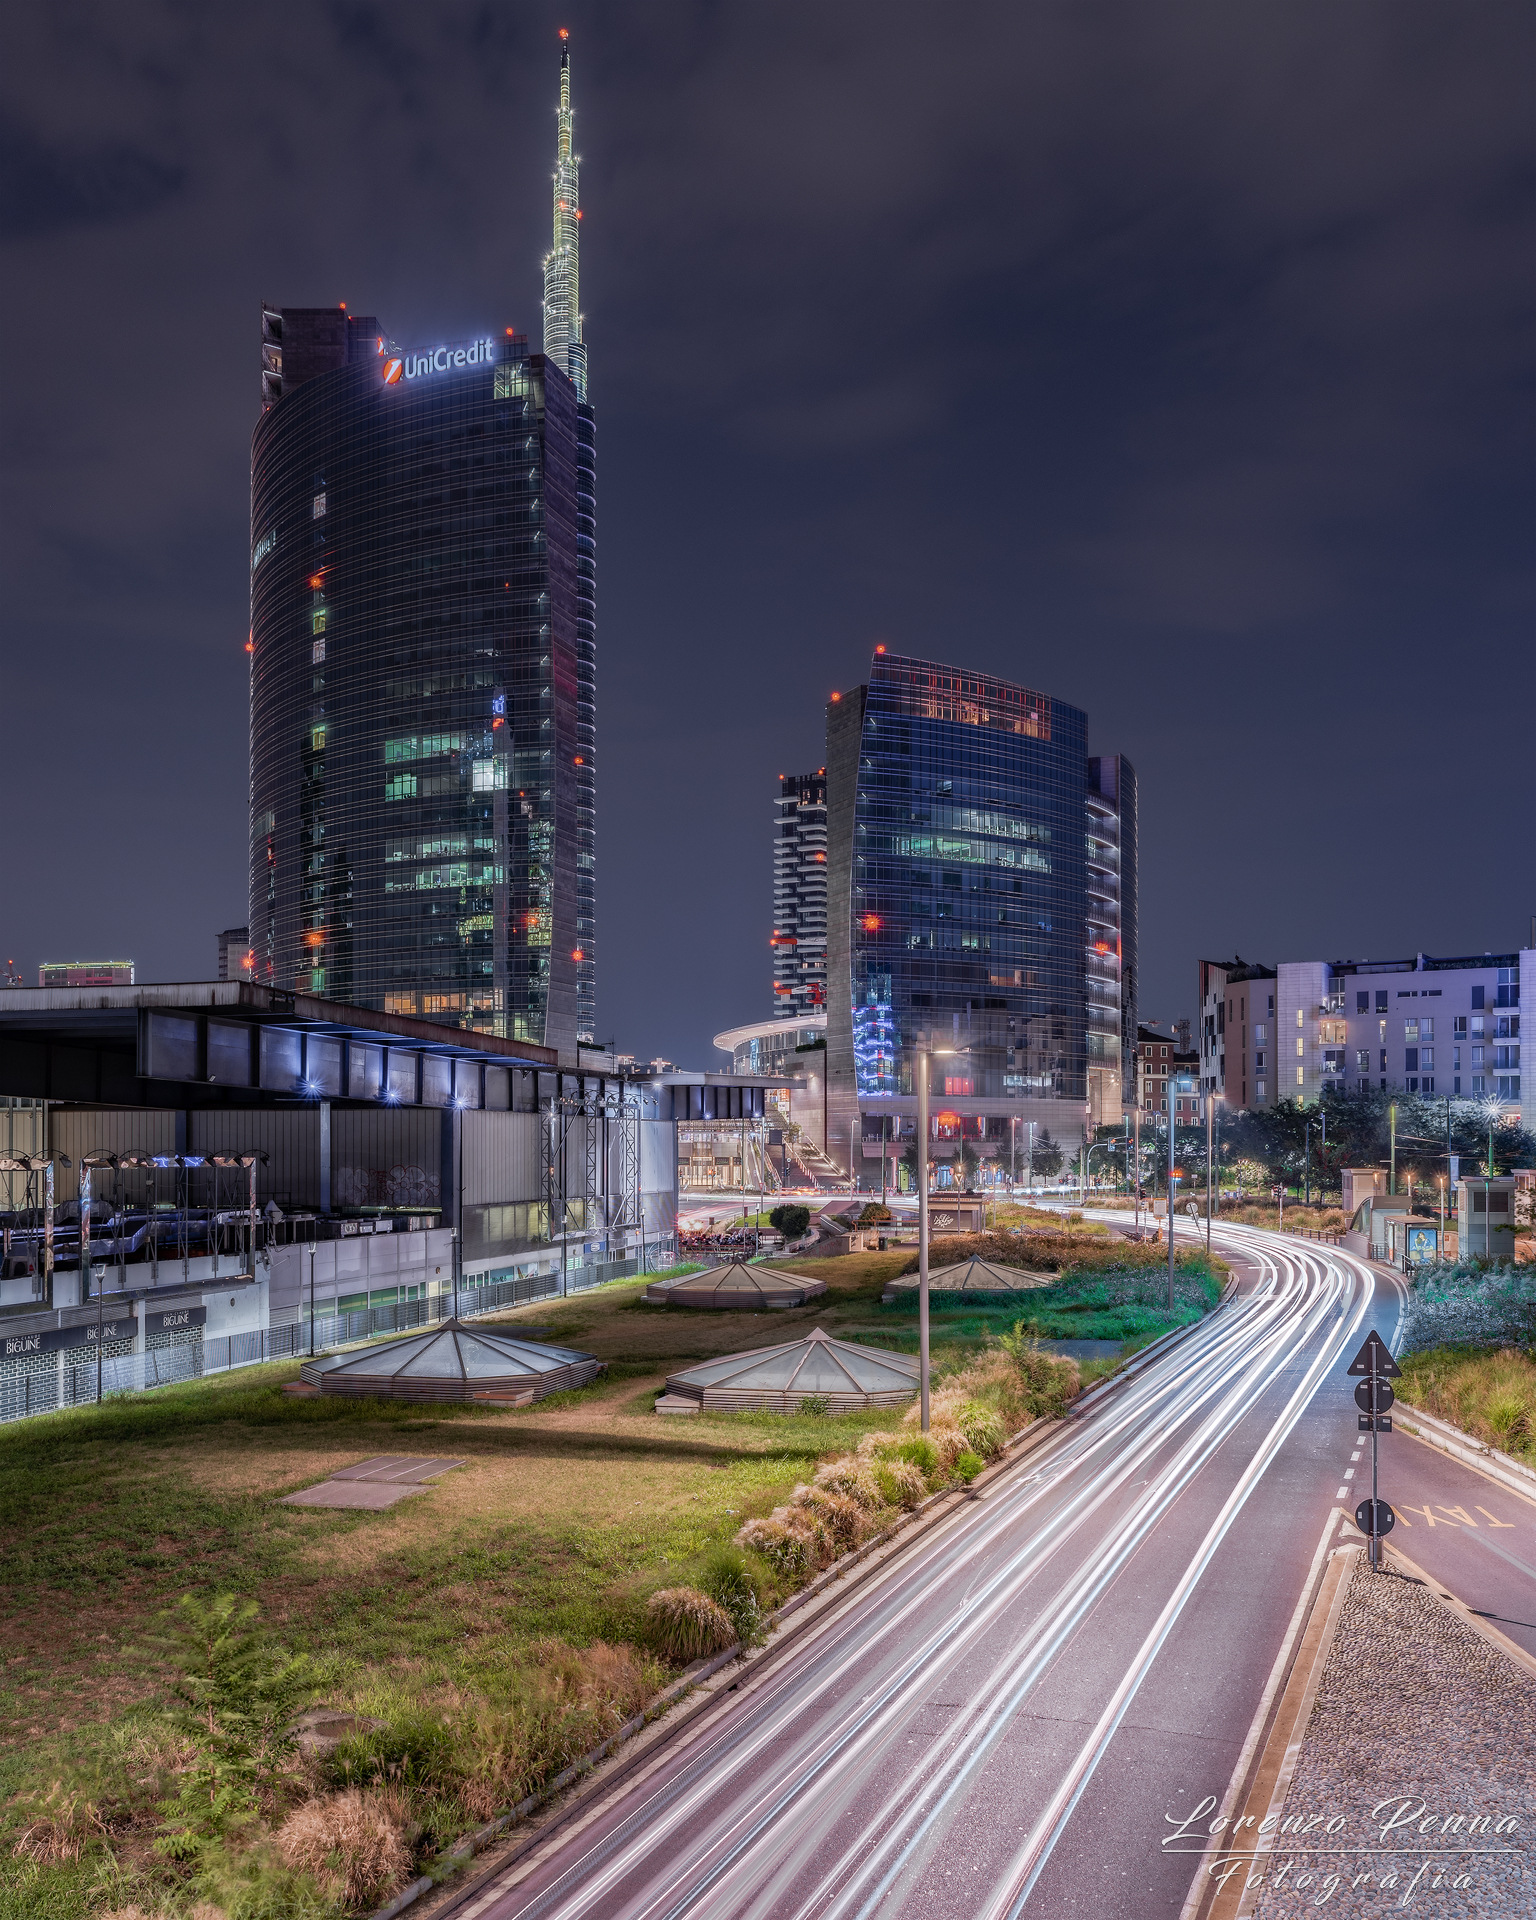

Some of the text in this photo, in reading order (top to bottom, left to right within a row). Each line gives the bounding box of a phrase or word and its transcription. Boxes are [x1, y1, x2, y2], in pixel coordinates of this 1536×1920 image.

[405, 338, 493, 379] UniCredit
[6, 1337, 41, 1354] BIGUINE
[1390, 1505, 1516, 1527] TAXI
